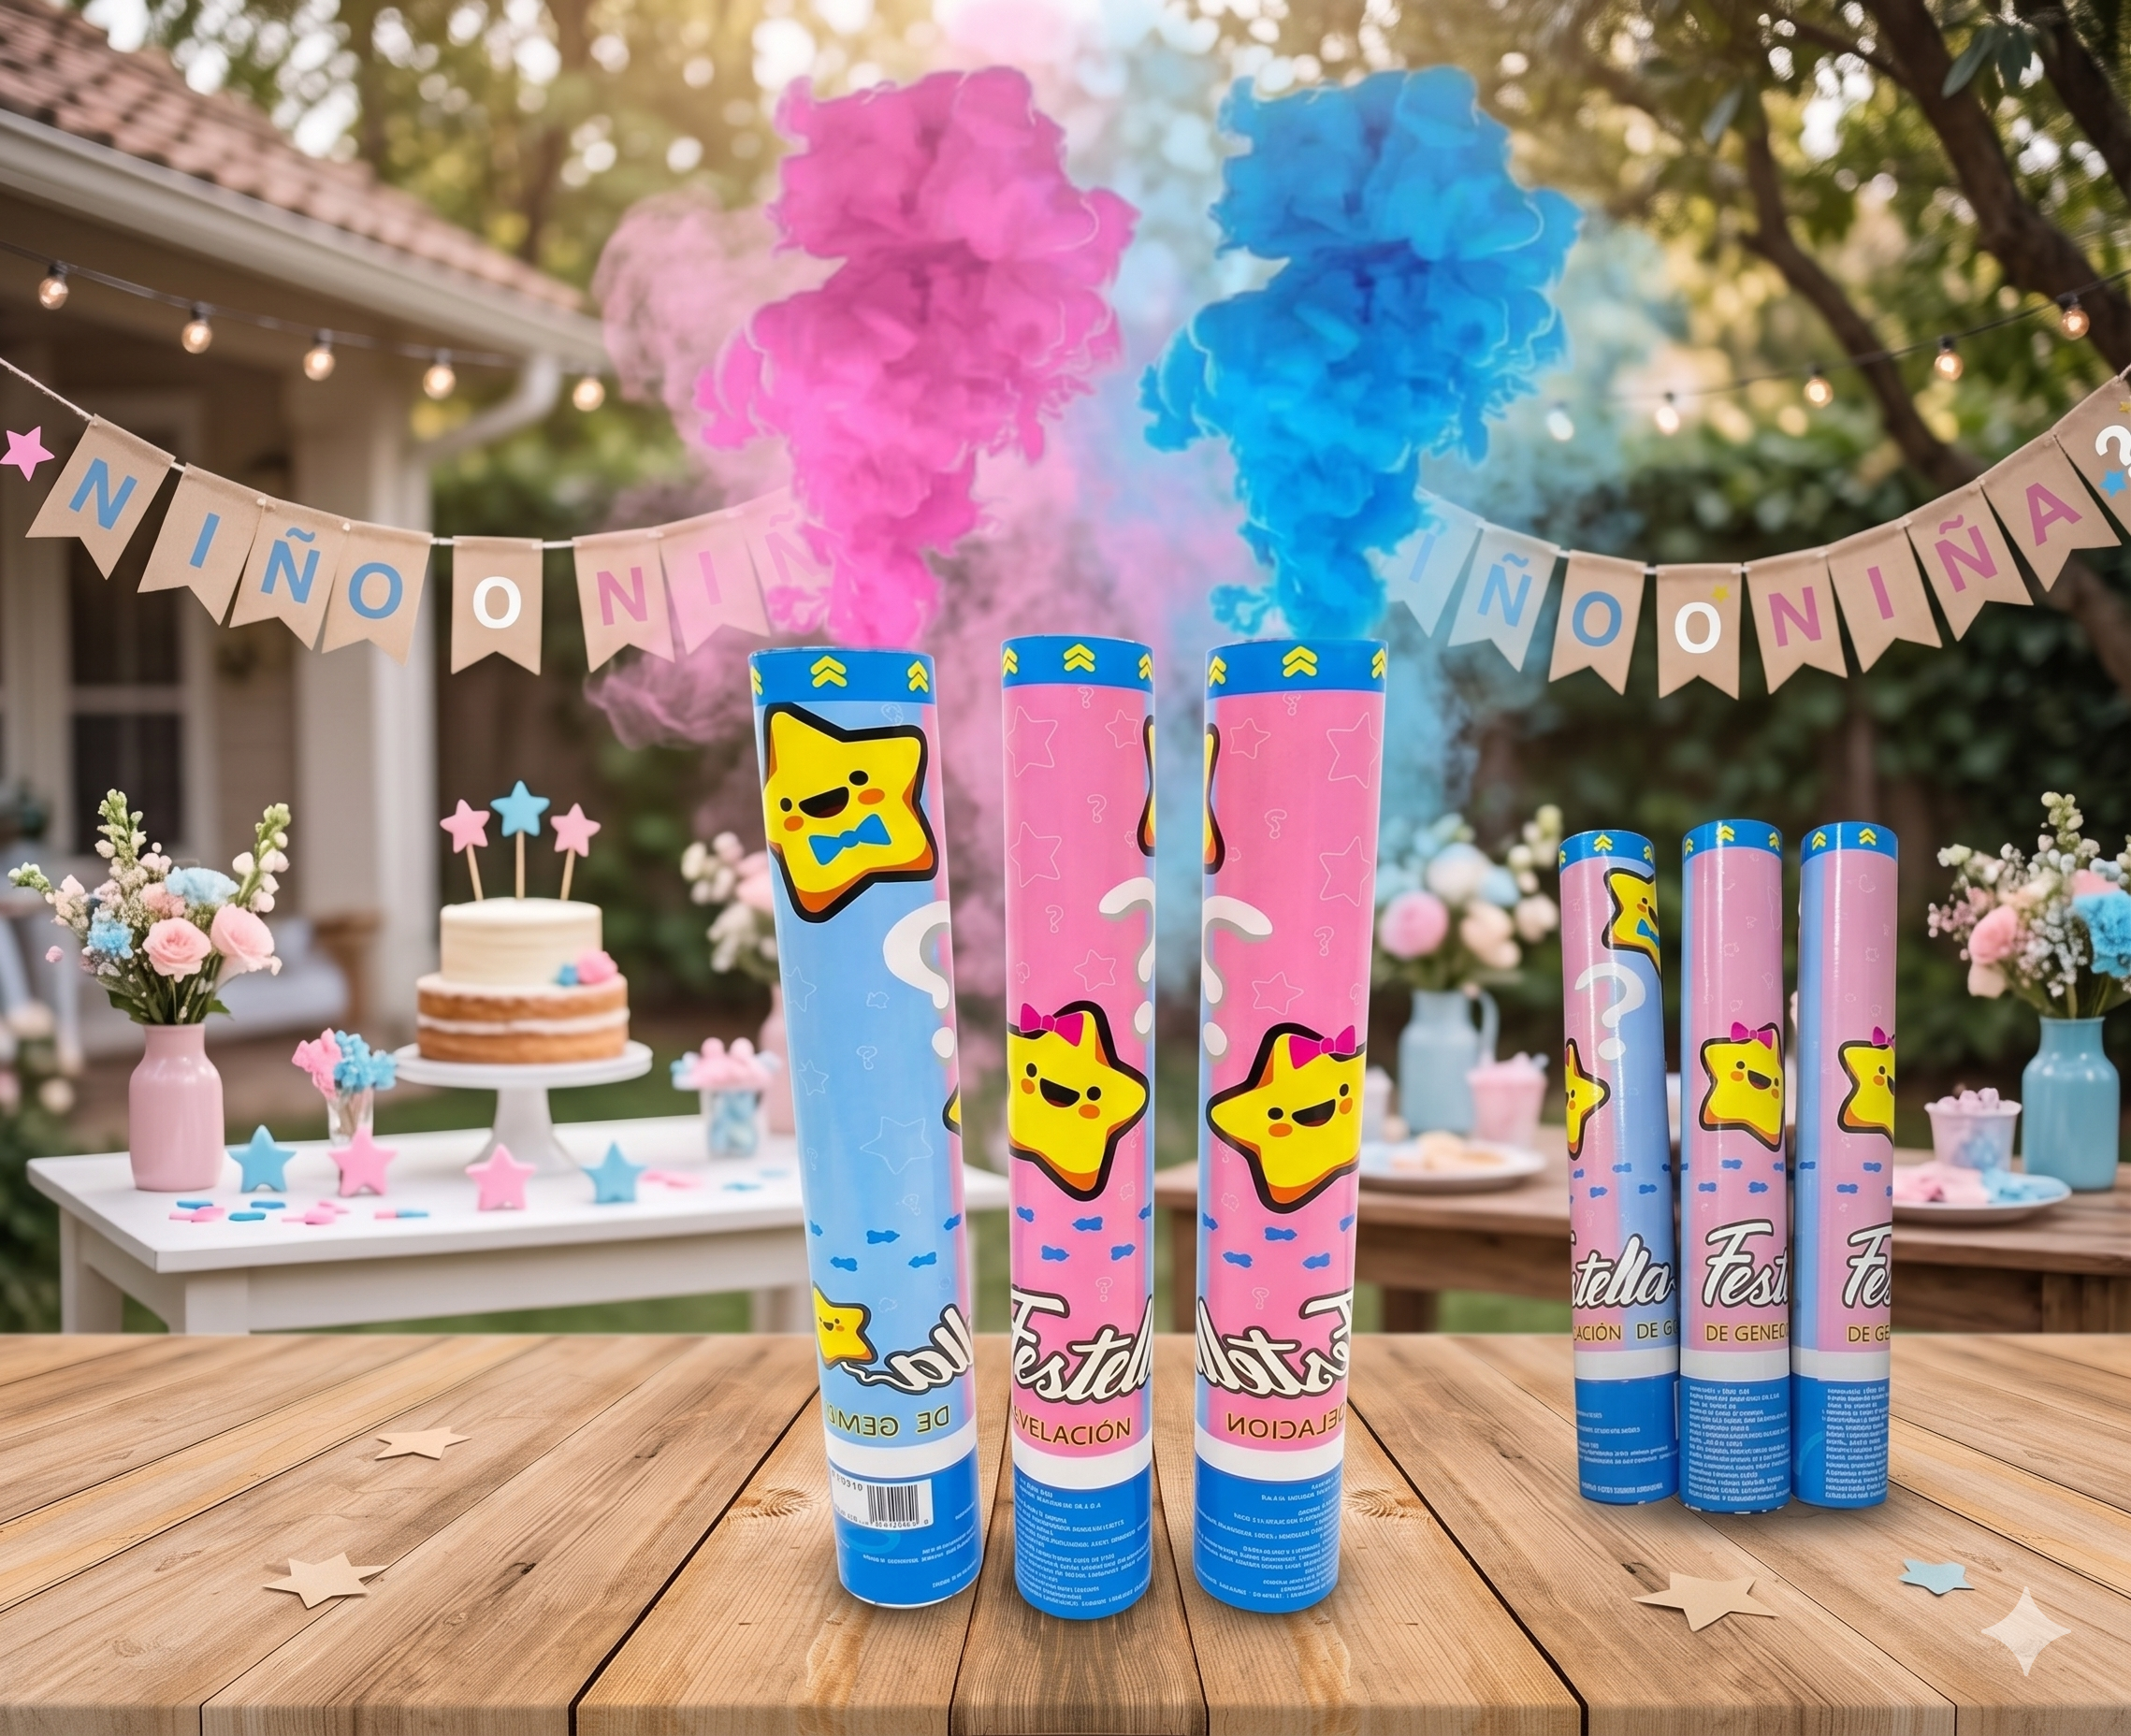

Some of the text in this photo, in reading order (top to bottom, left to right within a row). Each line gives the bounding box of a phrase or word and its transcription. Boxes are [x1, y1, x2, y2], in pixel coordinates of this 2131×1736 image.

[69, 457, 403, 619] NIÑO
[472, 576, 522, 629] O
[1674, 601, 1722, 654] O
[1636, 1323, 1659, 1339] DE
[1706, 1324, 1729, 1342] DE
[1848, 1326, 1870, 1342] DE
